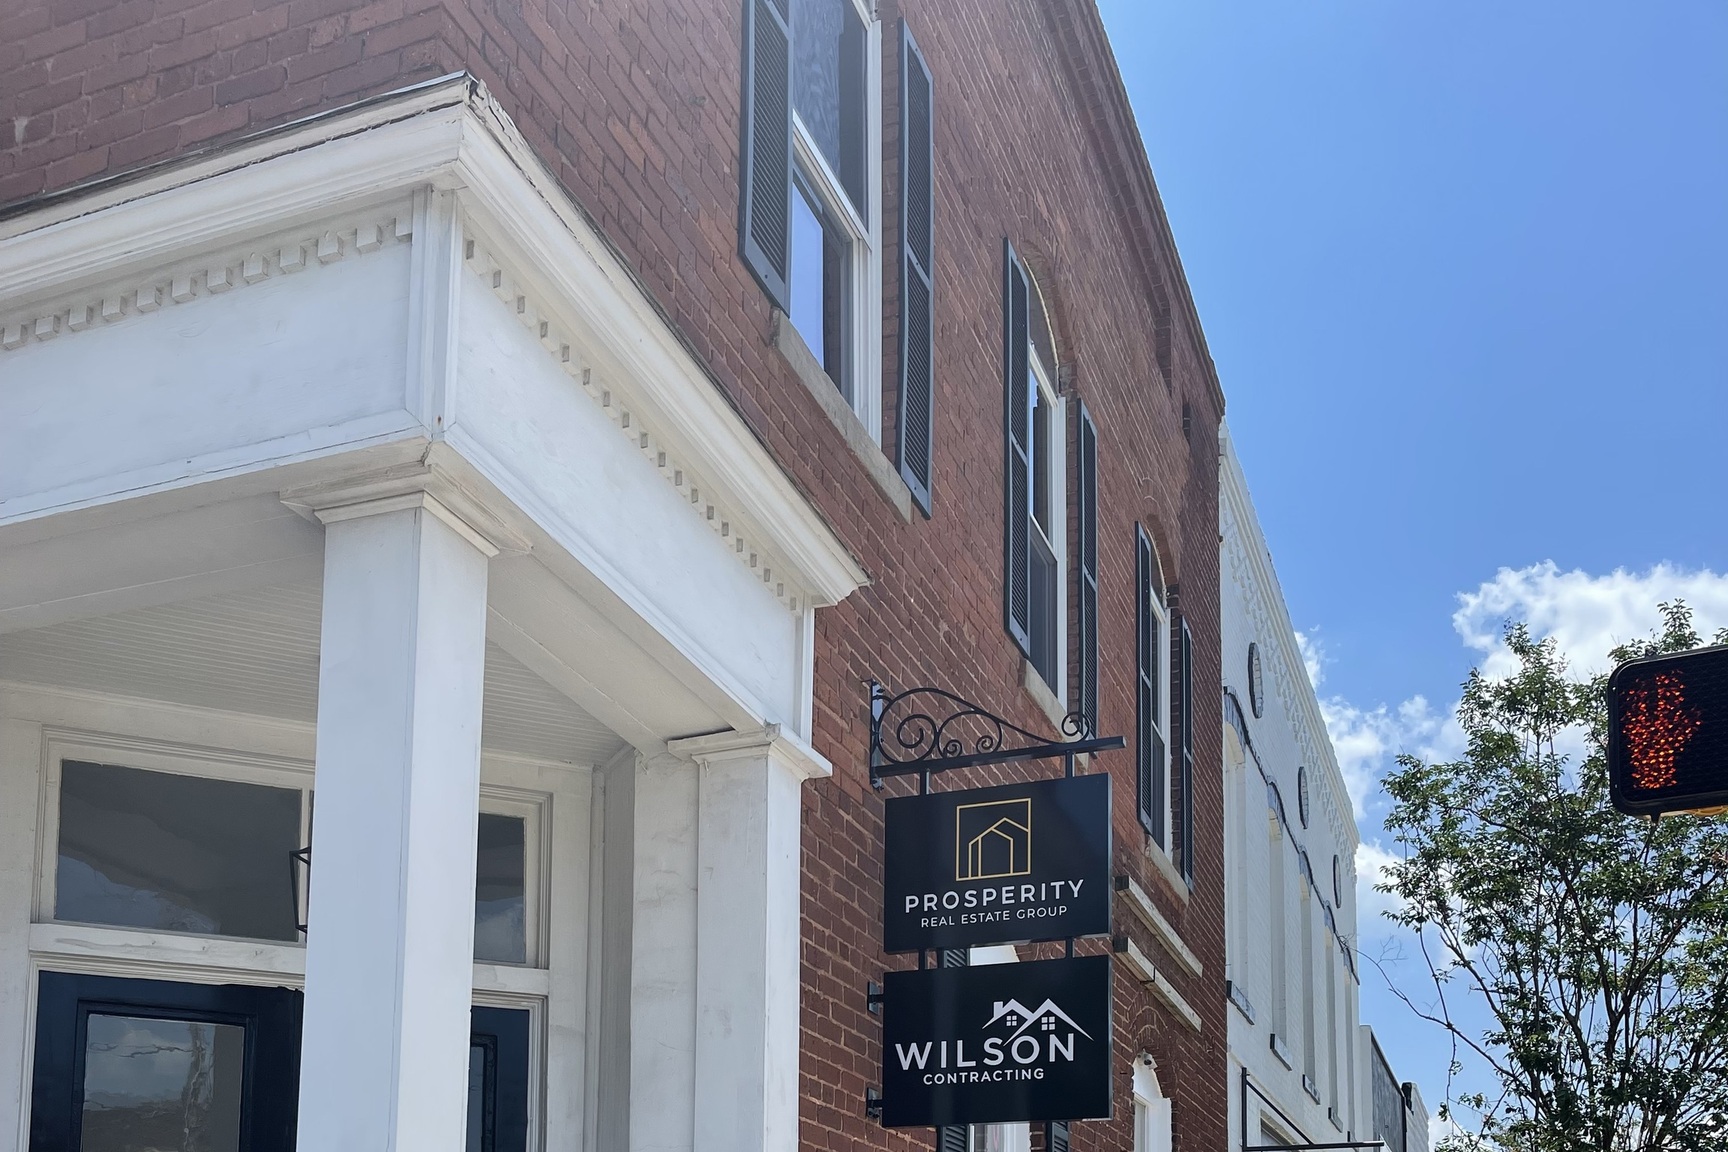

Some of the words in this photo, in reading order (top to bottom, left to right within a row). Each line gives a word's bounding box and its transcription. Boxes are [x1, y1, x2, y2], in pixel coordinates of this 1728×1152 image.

[905, 879, 1085, 914] PROSPERITY
[921, 915, 956, 928] REAL
[961, 910, 1011, 925] ESTATE
[1016, 905, 1068, 920] GROUP
[895, 1033, 1075, 1071] WILSON
[923, 1067, 1046, 1086] CONTRACTING
